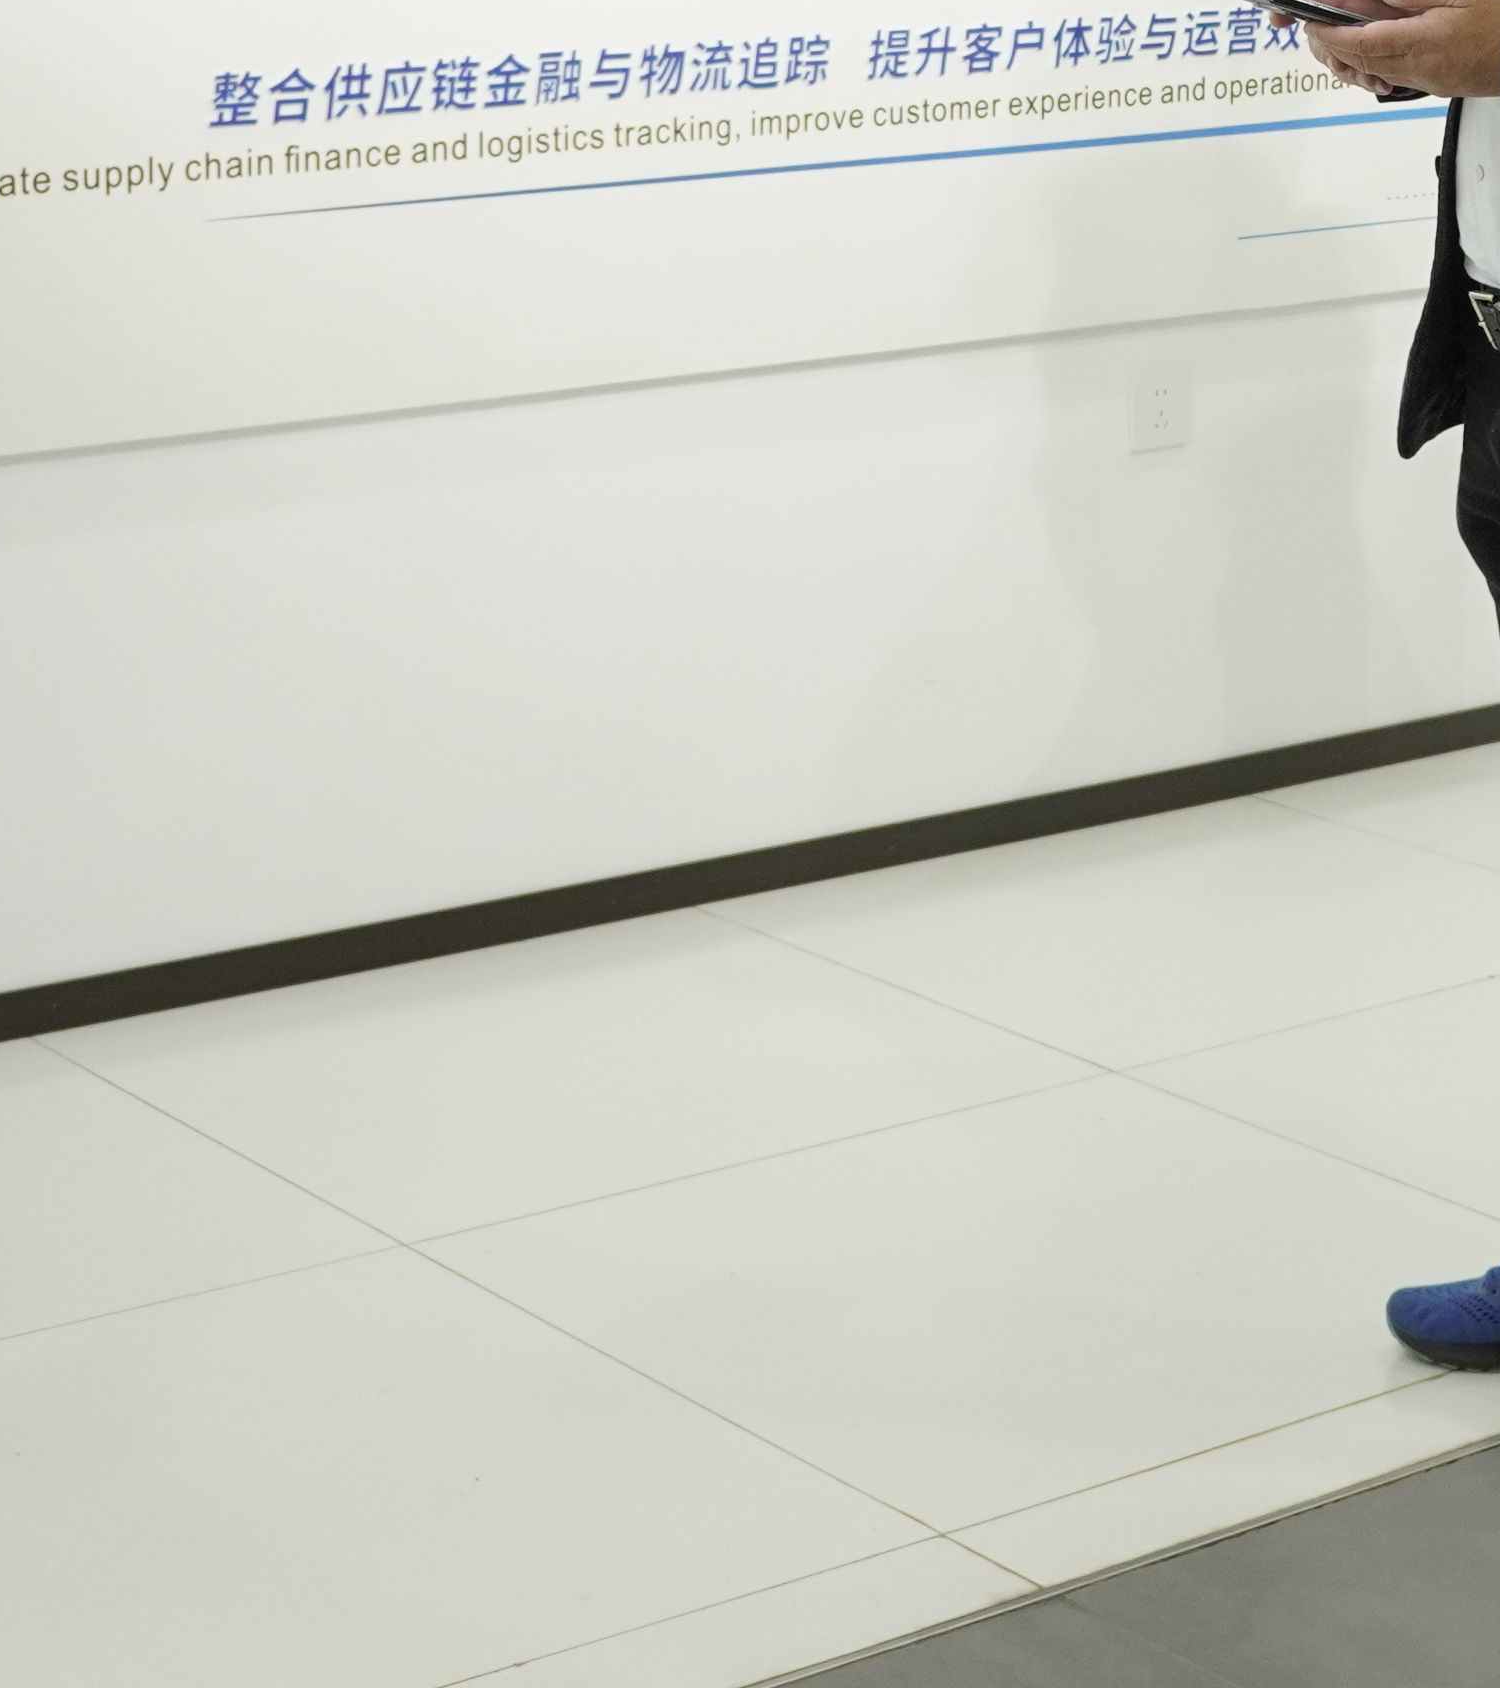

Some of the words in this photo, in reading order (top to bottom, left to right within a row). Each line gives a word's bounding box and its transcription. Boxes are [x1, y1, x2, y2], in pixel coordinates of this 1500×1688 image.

[61, 154, 176, 198] supply
[183, 147, 275, 183] chain
[282, 142, 403, 175] finance
[410, 131, 469, 166] and
[477, 123, 606, 165] logistics
[612, 114, 742, 149] tracking,
[750, 107, 865, 142] improve
[872, 97, 1003, 129] customer
[1007, 84, 1154, 122] experience
[1159, 75, 1207, 106] and
[208, 33, 832, 130] 整合供应链金融与物流追踪
